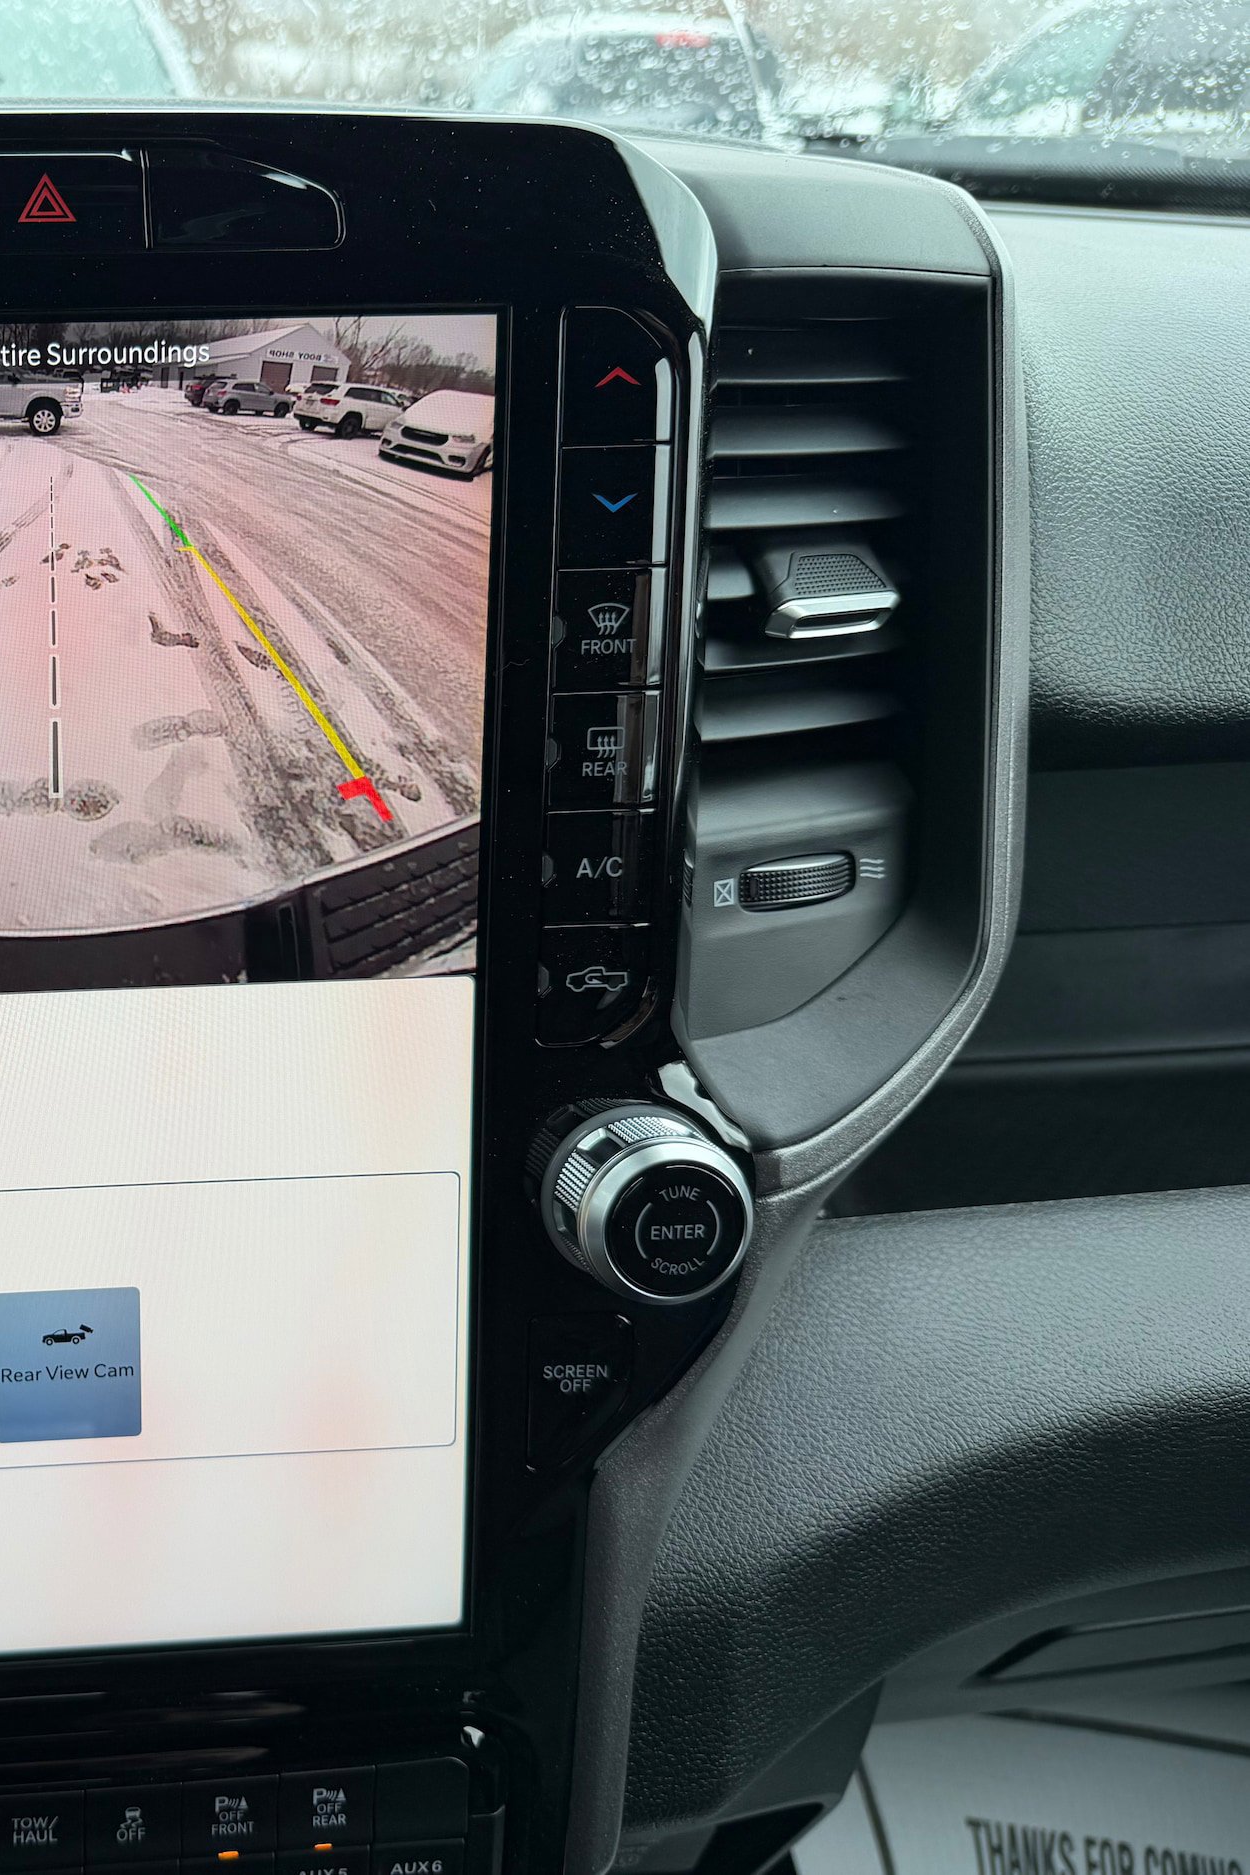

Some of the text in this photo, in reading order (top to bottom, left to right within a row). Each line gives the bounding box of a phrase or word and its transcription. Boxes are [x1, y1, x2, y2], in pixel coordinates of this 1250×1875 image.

[47, 342, 210, 368] Surroundings
[581, 638, 637, 655] FRONT
[581, 761, 627, 777] REAR
[576, 856, 624, 878] A/C
[659, 1185, 701, 1202] TUNE
[650, 1223, 705, 1240] ENTER
[650, 1257, 706, 1276] SCROLL
[0, 1362, 135, 1384] Rear View Cam
[542, 1365, 608, 1380] SCREEN
[560, 1378, 592, 1393] OFF
[316, 1802, 343, 1814] OFF
[219, 1811, 245, 1823] OFF
[312, 1813, 347, 1827] REAR
[116, 1827, 146, 1843] OFF
[211, 1820, 255, 1836] FRONT
[12, 1828, 58, 1847] HAUL
[964, 1816, 1243, 1875] THANKS FOR COM
